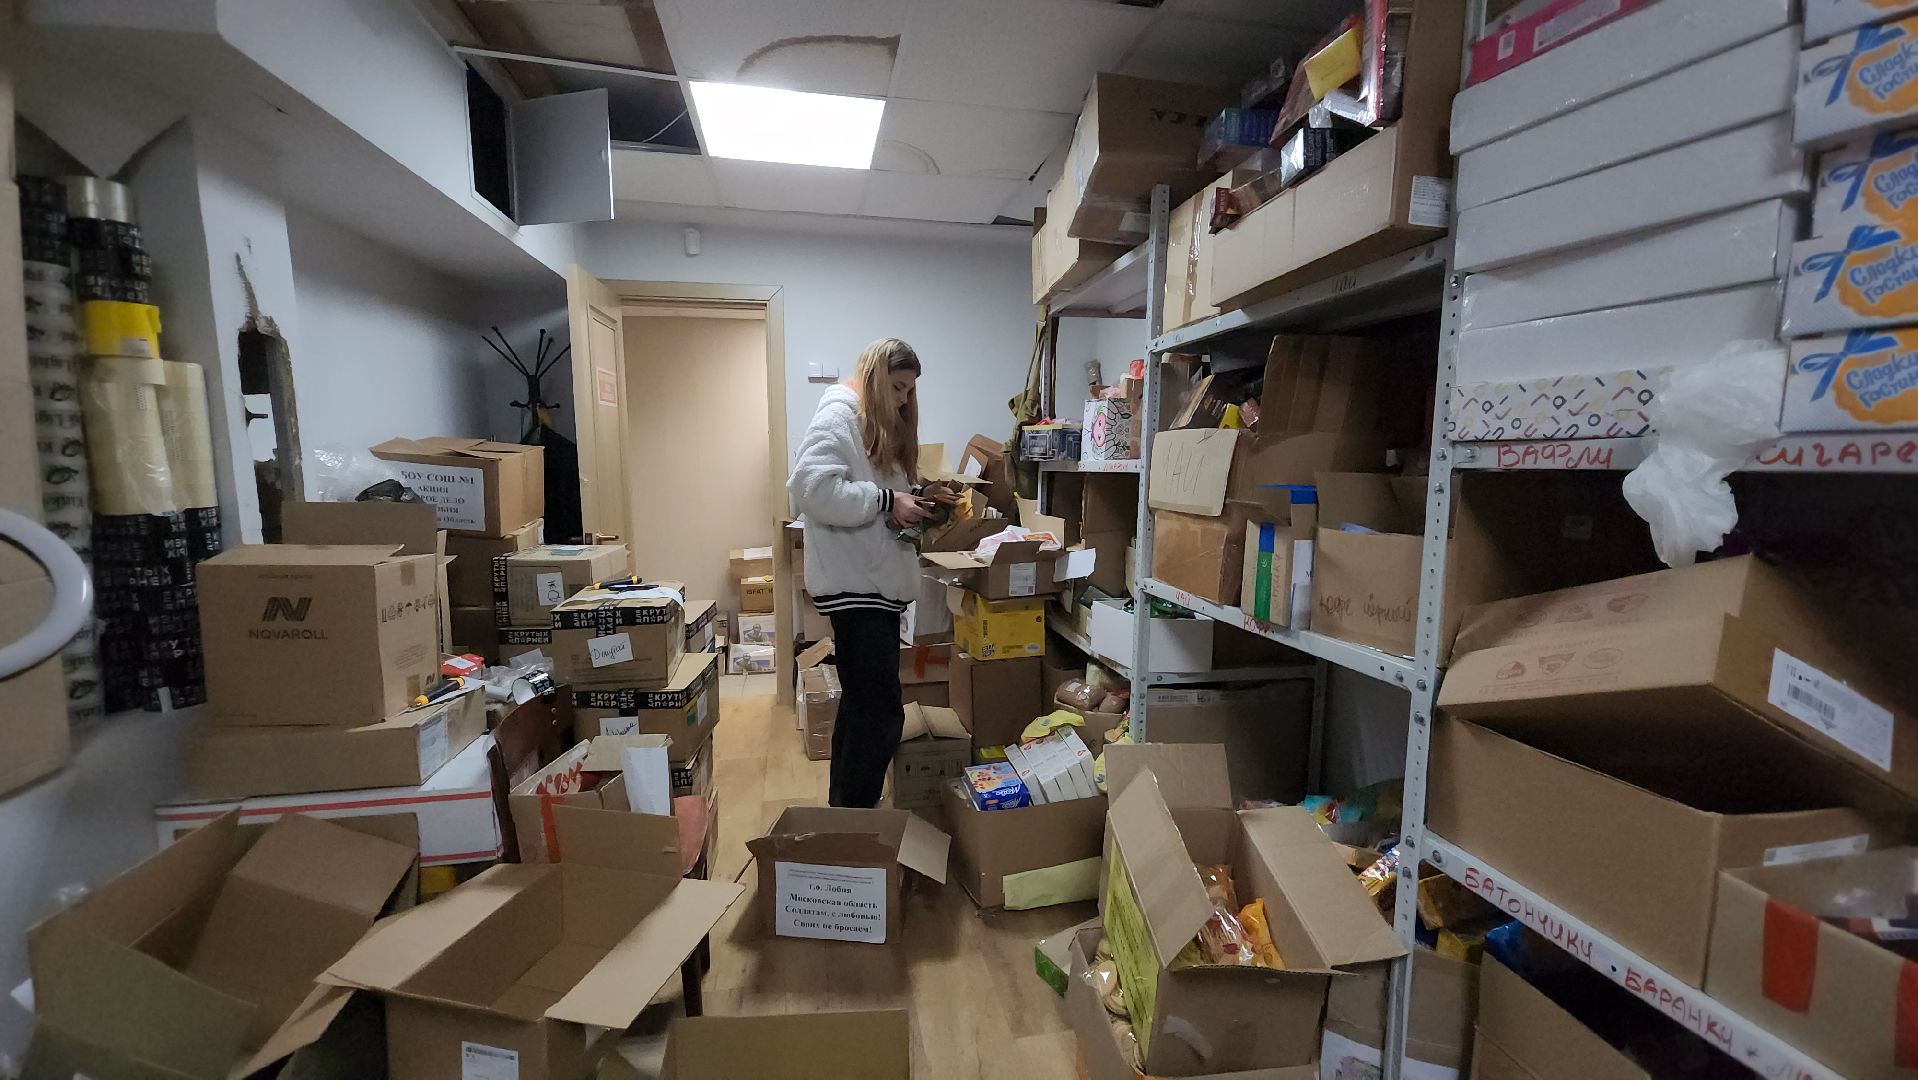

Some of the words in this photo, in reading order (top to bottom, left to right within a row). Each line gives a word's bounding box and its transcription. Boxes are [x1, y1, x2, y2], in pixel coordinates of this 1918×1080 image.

[1859, 40, 1918, 86] Сладк
[1849, 244, 1918, 287] Сладки
[1846, 350, 1918, 391] Сладки
[1755, 441, 1918, 467] СИГАРЕ
[248, 629, 328, 640] NOVAROLL
[789, 892, 842, 906] Московская
[843, 900, 878, 909] область
[837, 912, 881, 922] любовью!
[1465, 866, 1593, 960] БАТОНЧИКИ
[793, 918, 820, 929] Своих
[834, 923, 873, 934] бросаем!
[1625, 967, 1733, 1054] БАРАНКИ
